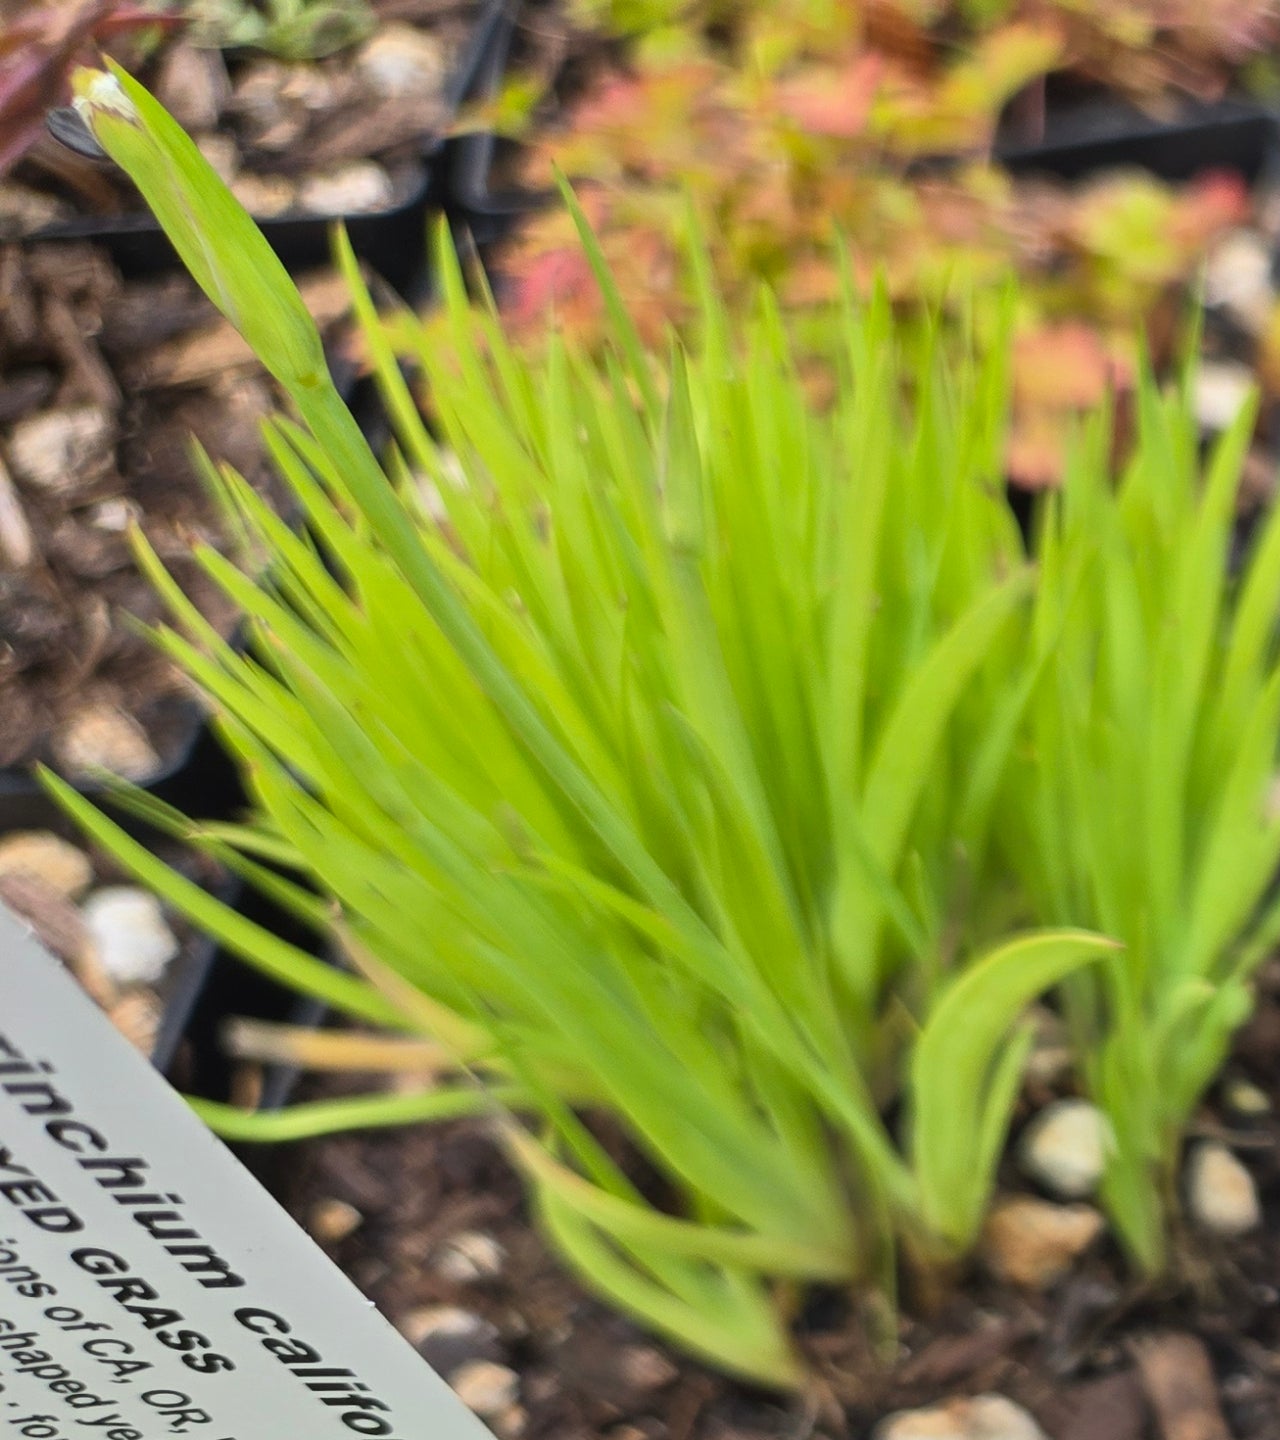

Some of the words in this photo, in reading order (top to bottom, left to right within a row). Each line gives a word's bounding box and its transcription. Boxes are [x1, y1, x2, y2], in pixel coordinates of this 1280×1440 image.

[43, 1306, 113, 1332] of
[81, 1338, 154, 1384] CA,
[140, 1389, 213, 1434] OR,
[69, 1247, 236, 1374] GRASS
